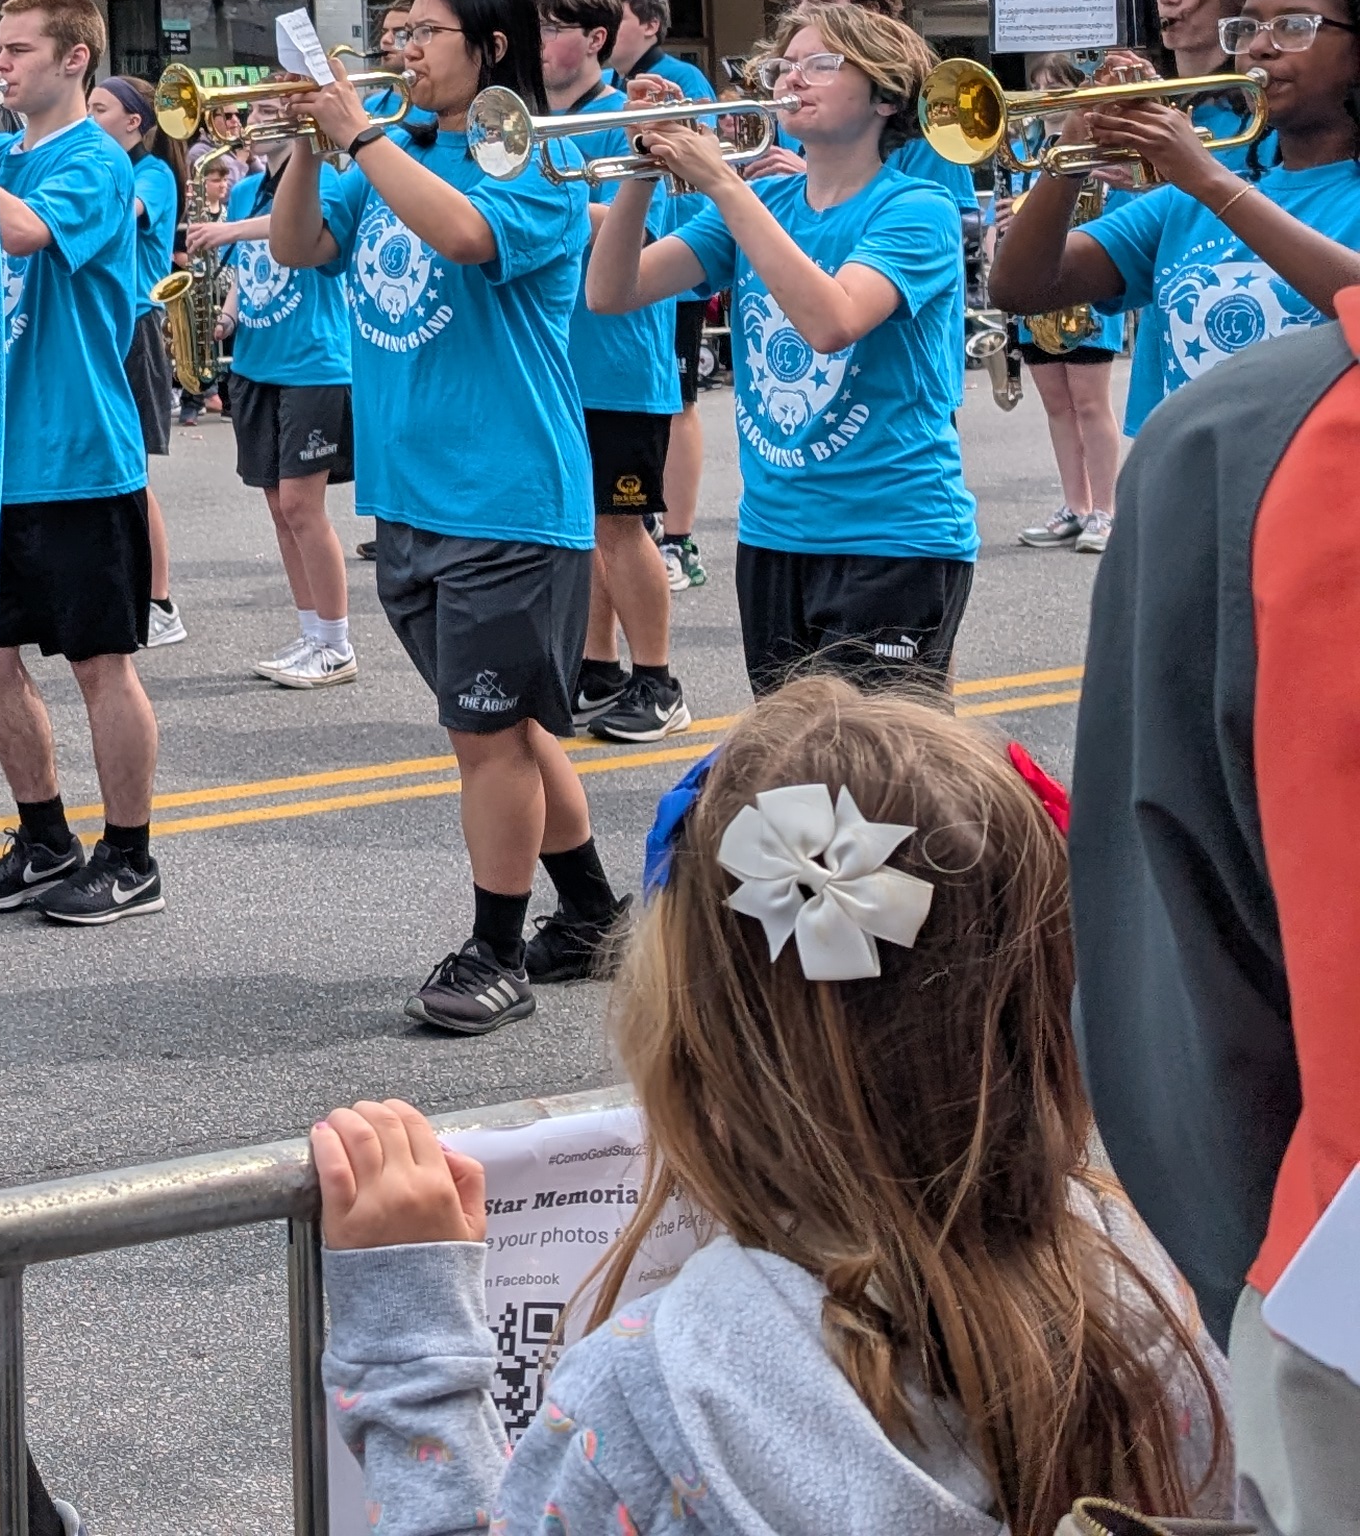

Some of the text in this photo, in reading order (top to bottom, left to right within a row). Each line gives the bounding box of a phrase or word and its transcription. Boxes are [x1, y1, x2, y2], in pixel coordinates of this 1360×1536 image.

[272, 290, 303, 324] BAND
[407, 305, 454, 350] BAND
[735, 394, 871, 469] MARCHING BAND
[299, 449, 314, 461] THE
[874, 642, 914, 659] PUMA
[458, 694, 480, 709] THE
[484, 1198, 528, 1216] Star
[532, 1184, 643, 1210] Memoria
[497, 1231, 537, 1252] your
[540, 1226, 609, 1247] photos
[655, 1219, 675, 1239] the
[495, 1272, 560, 1287] Facebook
